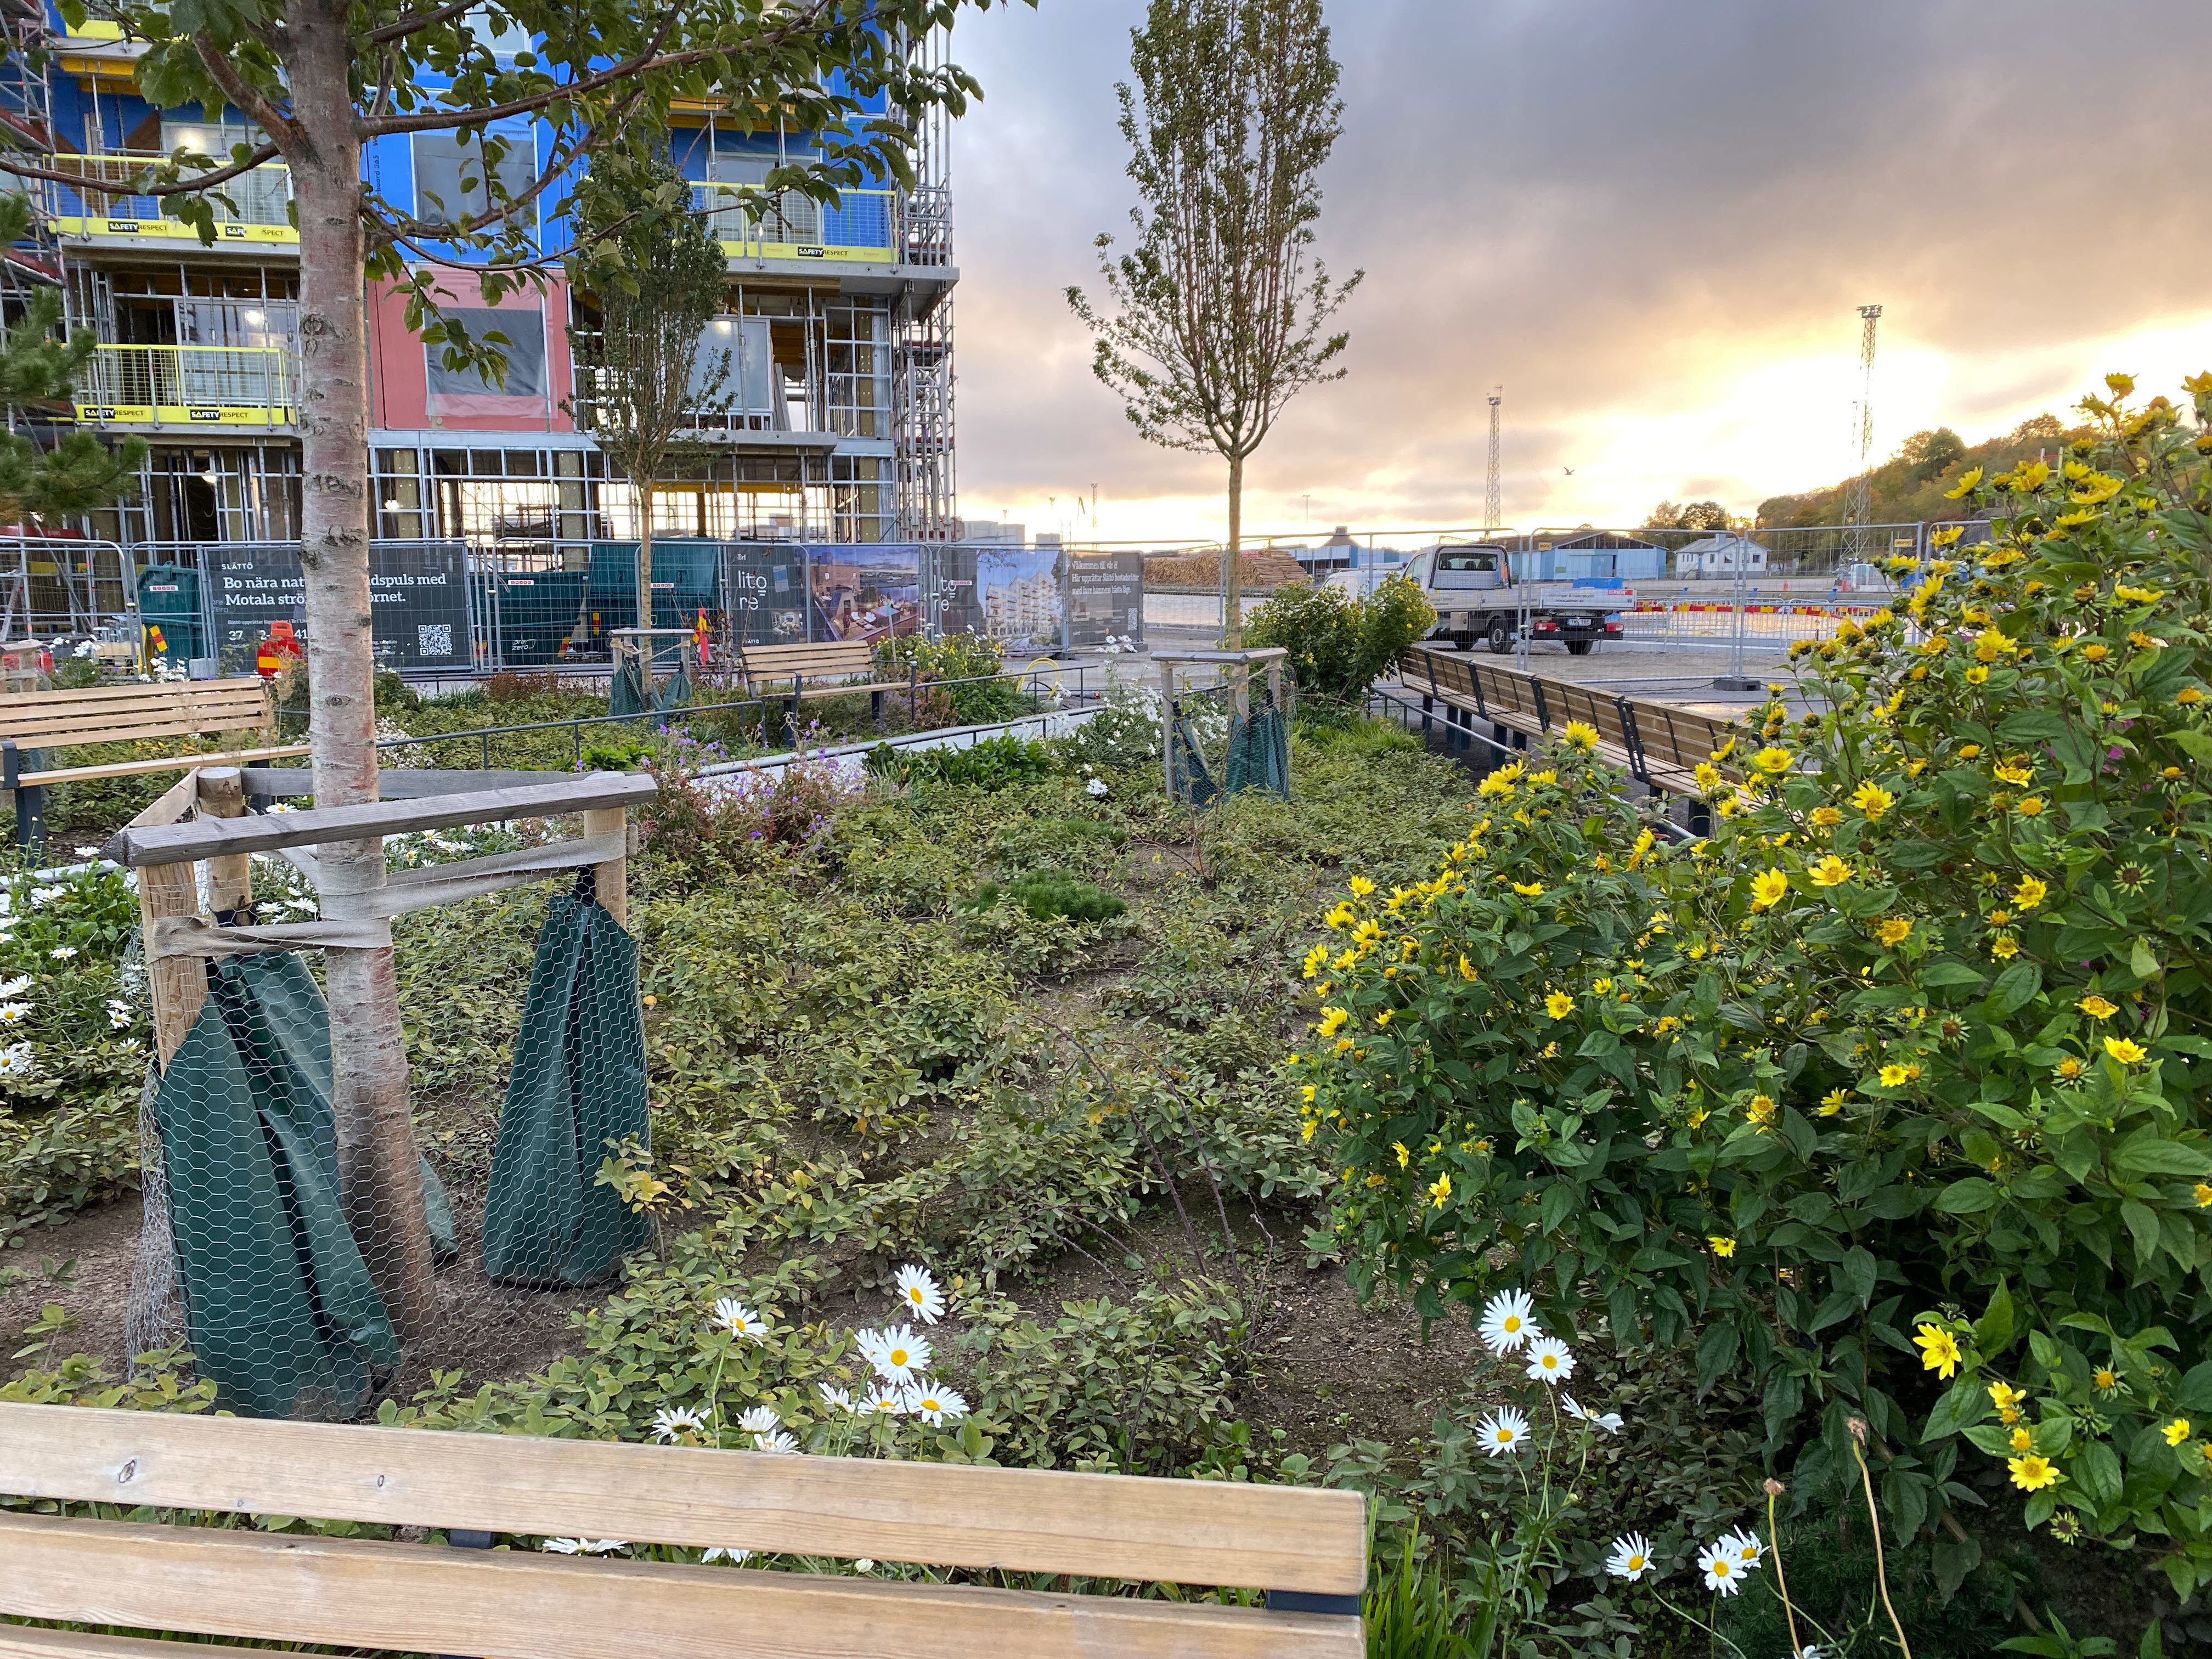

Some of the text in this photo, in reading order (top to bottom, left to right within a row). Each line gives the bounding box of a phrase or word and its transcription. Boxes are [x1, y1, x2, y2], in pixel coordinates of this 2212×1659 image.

[221, 562, 253, 570] SLÄTTÖ
[1072, 560, 1099, 569] Välkommen
[223, 577, 242, 589] Bo
[245, 577, 278, 589] nära
[416, 573, 447, 585] med
[1071, 573, 1139, 584] Här upprättar Slättö bostadsrätter
[1072, 585, 1082, 595] med
[1092, 585, 1111, 594] hamnens
[1111, 585, 1122, 593] bästa
[224, 591, 406, 606] Motala strö örnet.
[228, 630, 244, 641] 37
